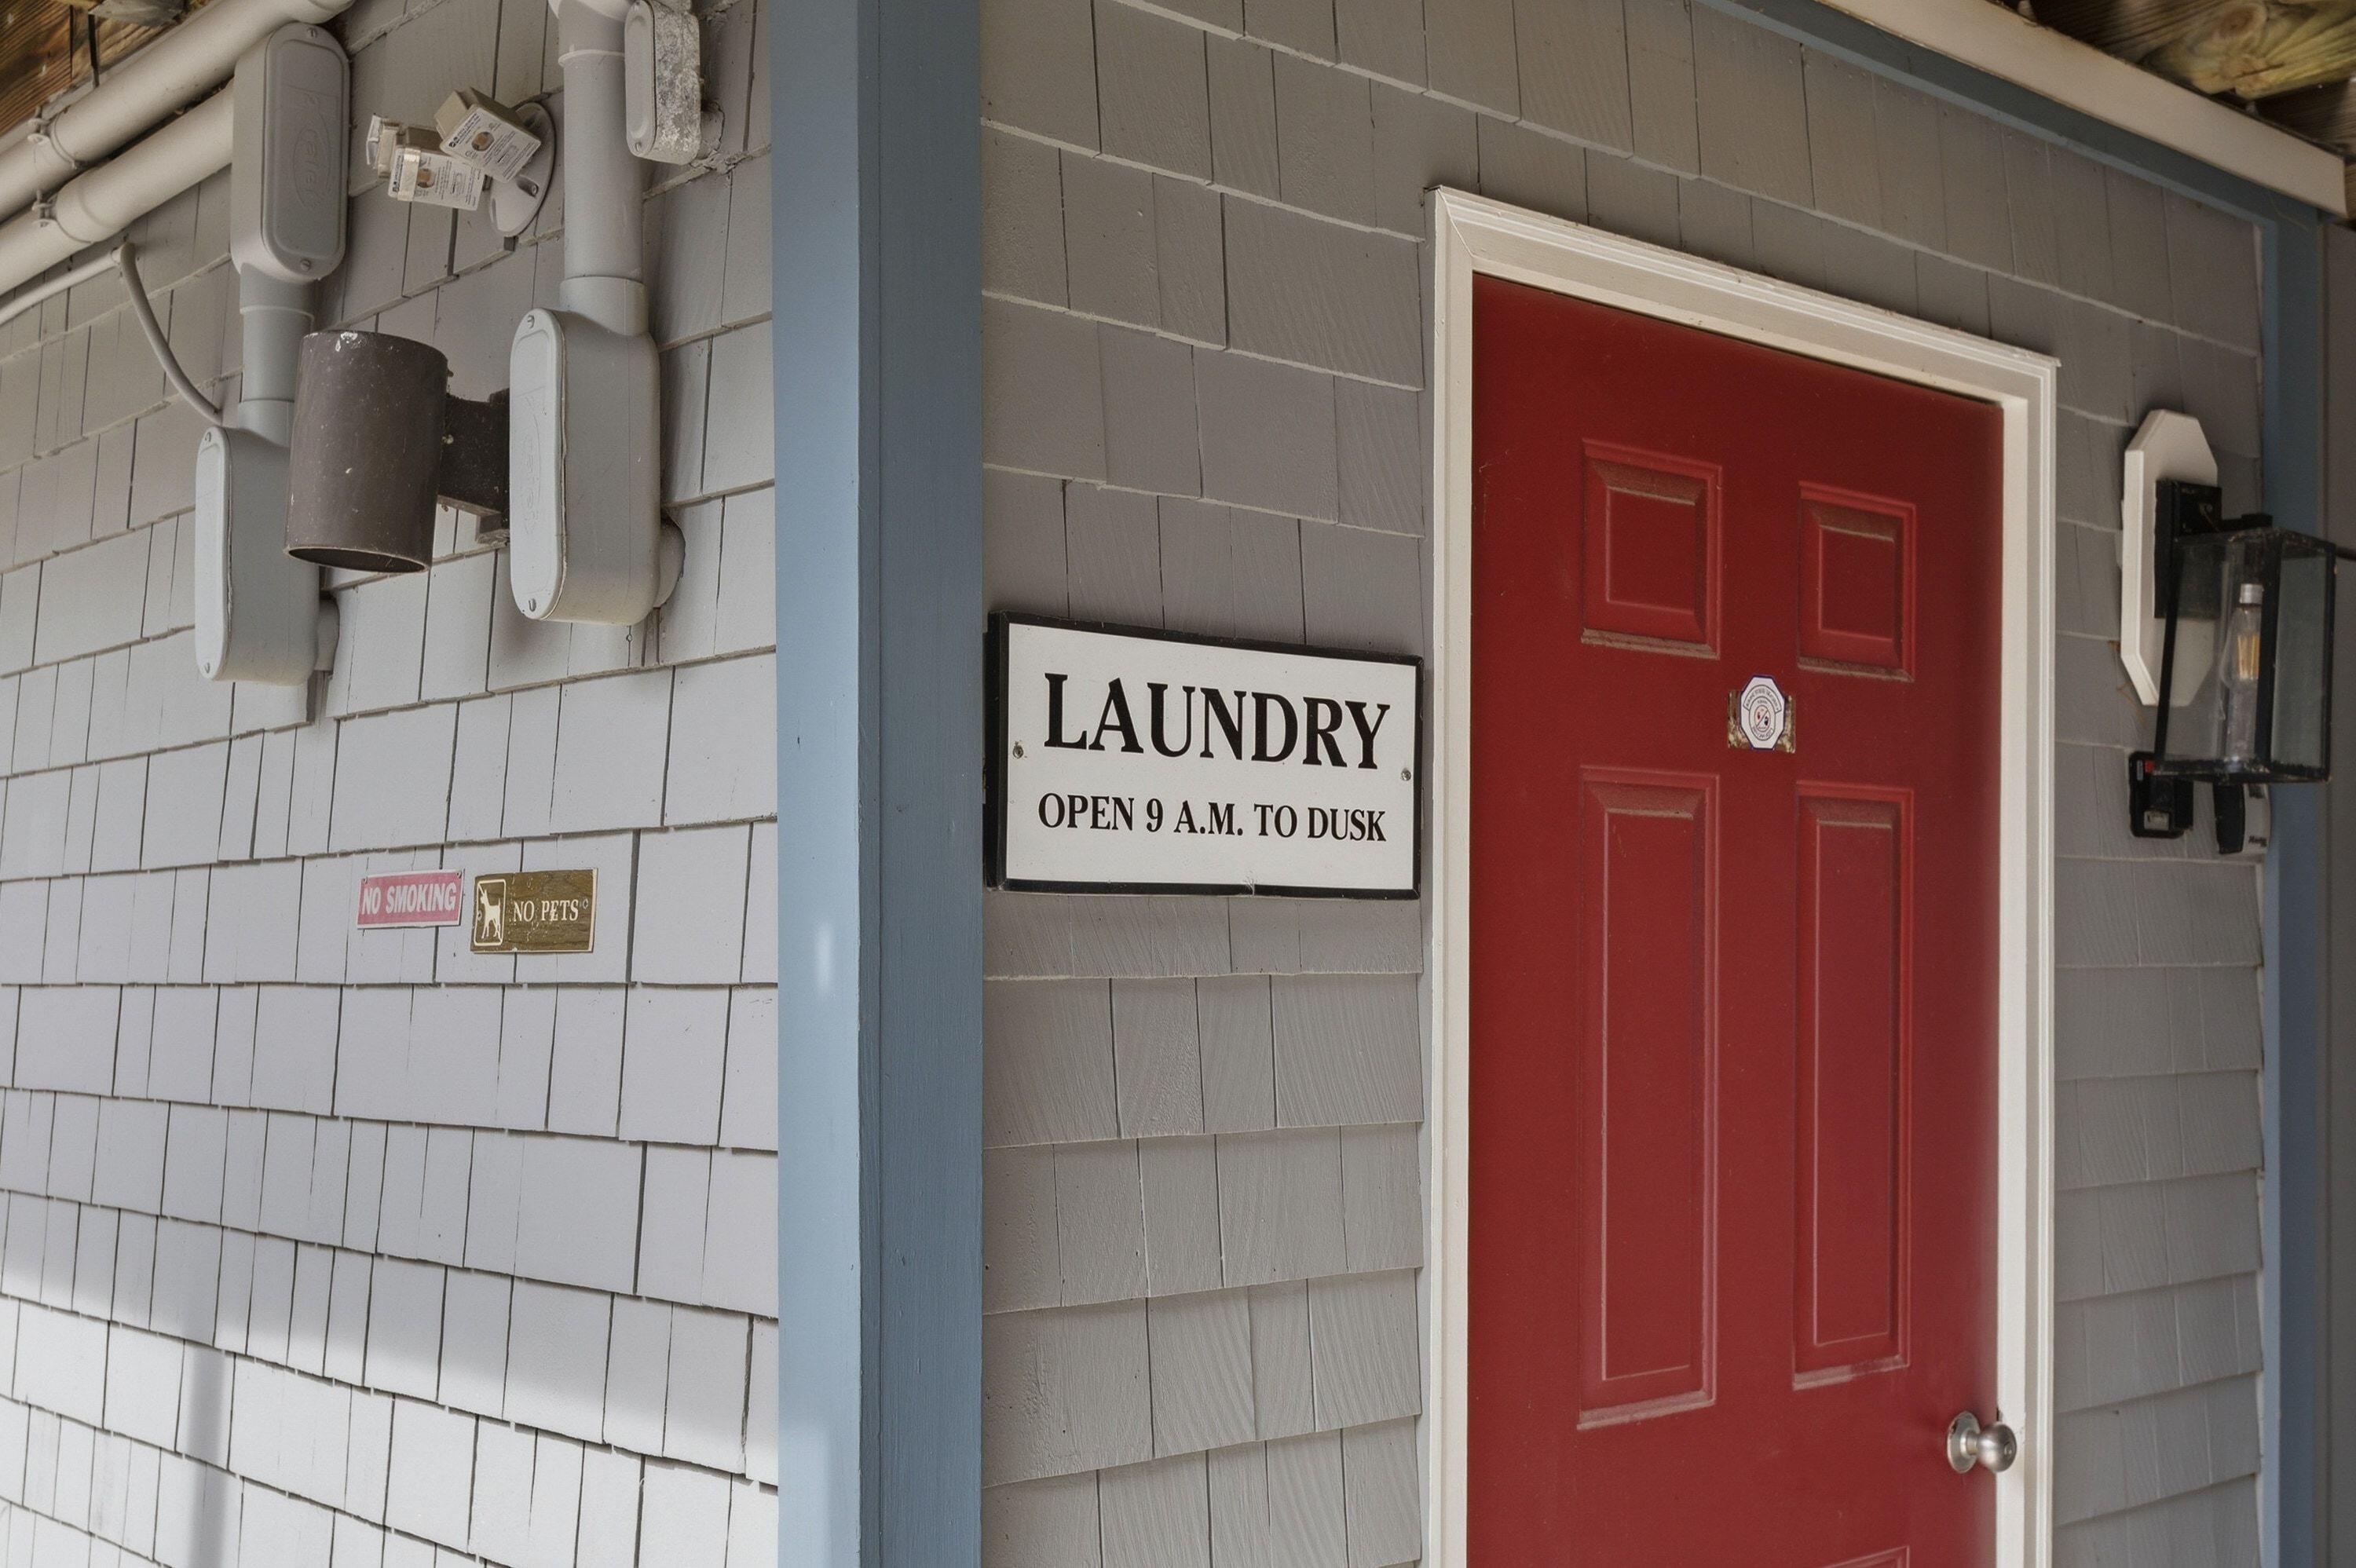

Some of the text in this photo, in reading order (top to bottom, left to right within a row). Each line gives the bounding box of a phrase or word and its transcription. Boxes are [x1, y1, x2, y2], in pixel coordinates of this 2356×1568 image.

[1044, 673, 1390, 769] LAUNDRY
[1038, 792, 1386, 842] OPEN 9 A.M. TO DUSK
[360, 882, 457, 916] NO SMOKING
[513, 899, 579, 922] NO PETS
